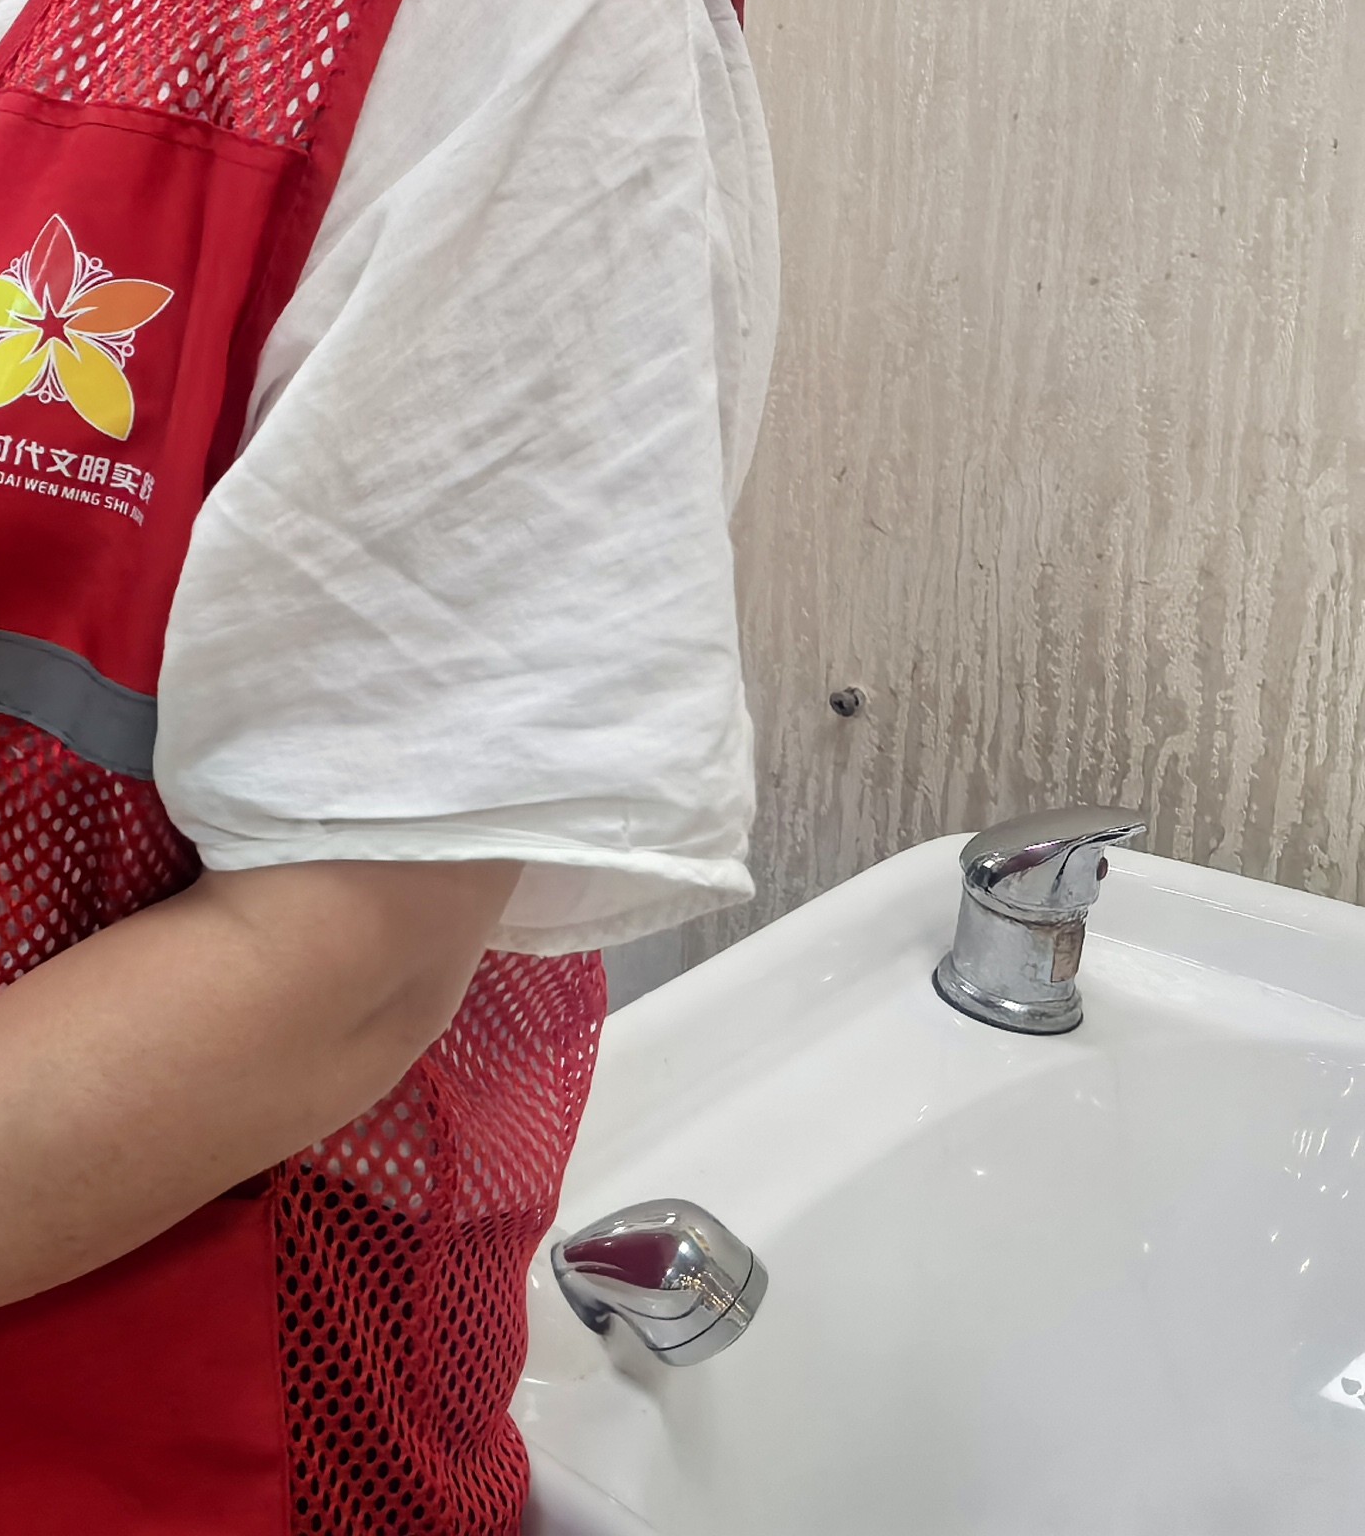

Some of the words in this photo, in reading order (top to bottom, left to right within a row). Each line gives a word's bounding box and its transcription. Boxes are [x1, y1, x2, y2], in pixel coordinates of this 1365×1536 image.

[24, 476, 59, 497] WEN
[61, 485, 102, 507] MING
[103, 495, 130, 516] SHI
